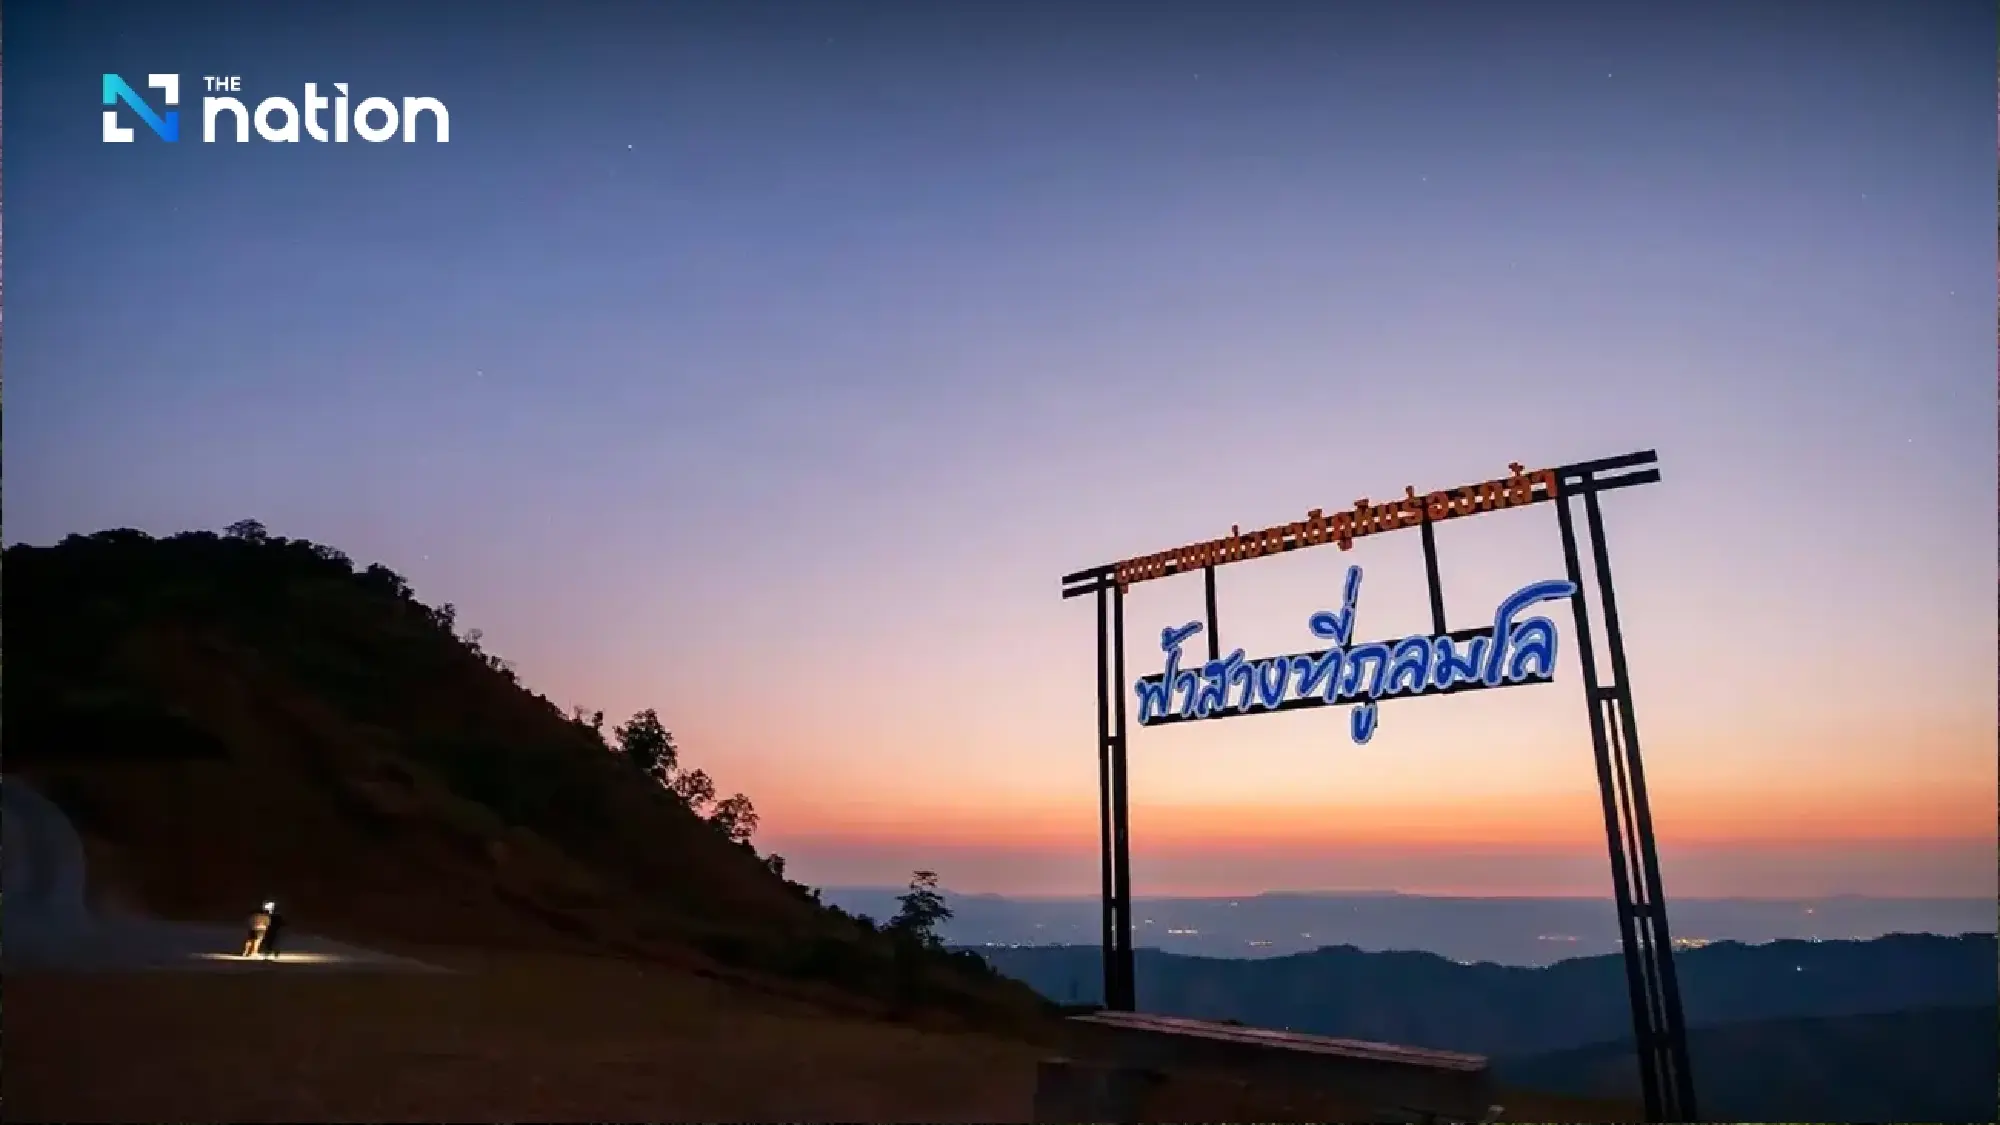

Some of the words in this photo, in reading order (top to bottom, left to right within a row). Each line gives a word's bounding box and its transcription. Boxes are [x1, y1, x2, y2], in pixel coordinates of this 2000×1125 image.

[1135, 565, 1577, 744] ฟ้าสางที่ภูลมโล
